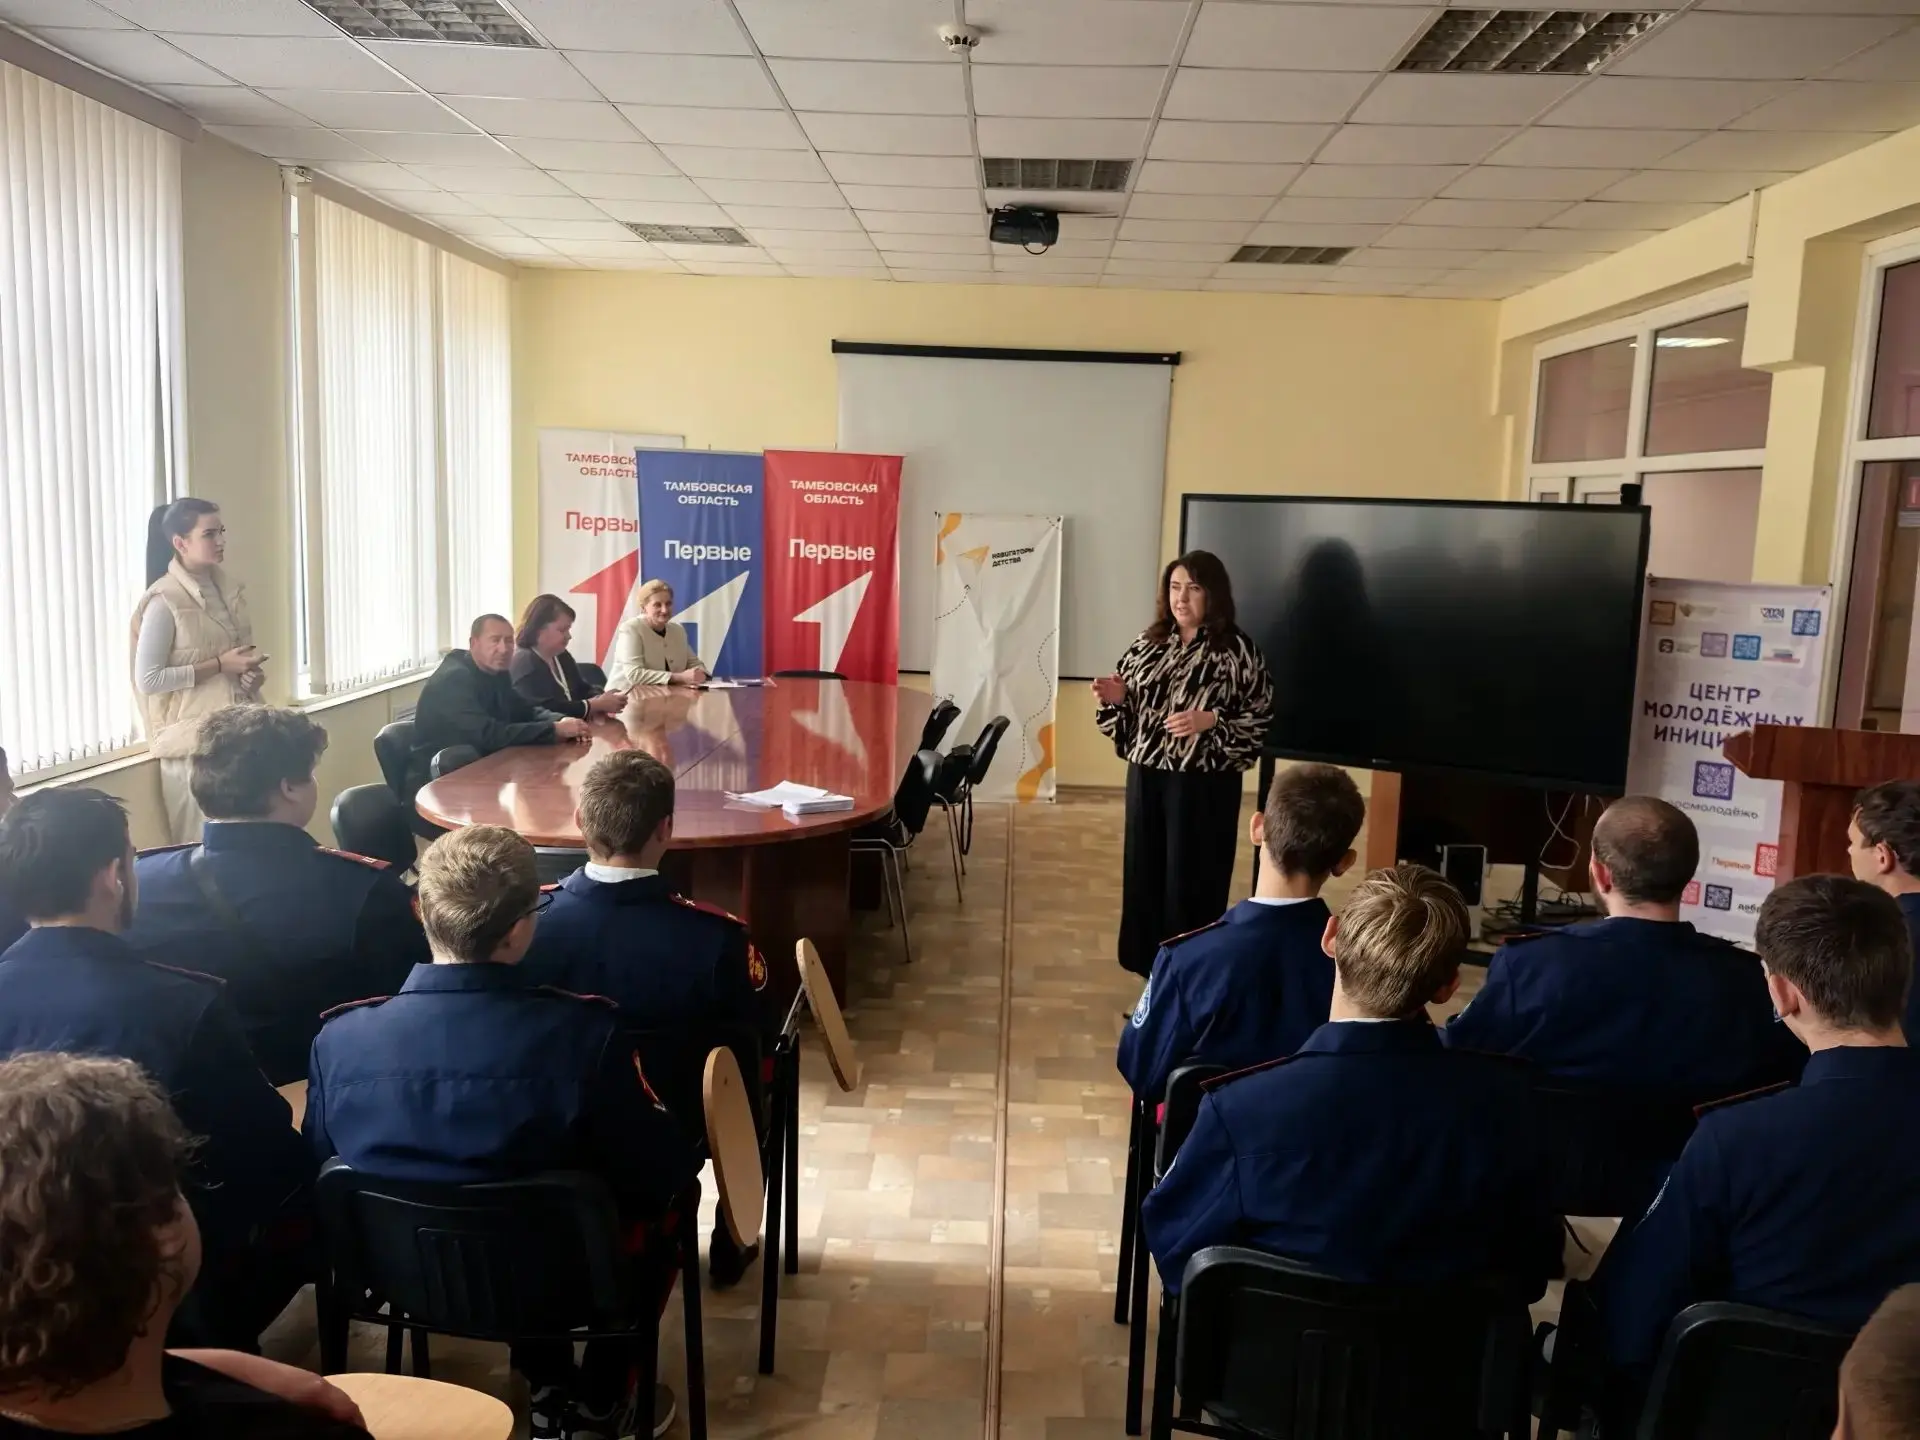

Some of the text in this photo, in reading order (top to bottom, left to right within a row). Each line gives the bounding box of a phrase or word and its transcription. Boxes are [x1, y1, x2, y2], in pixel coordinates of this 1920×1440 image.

[565, 452, 637, 465] ТАМБОВСК
[580, 466, 639, 479] ОБЛАСТЬ
[663, 481, 753, 494] ТАМБОВСКАЯ
[789, 480, 878, 493] ТАМБОВСКАЯ
[677, 495, 739, 506] ОБЛАСТЬ
[804, 493, 864, 505] ОБЛАСТЬ
[566, 511, 638, 536] Первы
[664, 539, 752, 566] Первые
[789, 538, 876, 565] Первые
[1689, 682, 1761, 704] ЦЕНТР
[1653, 724, 1730, 750] ИНИЦИ
